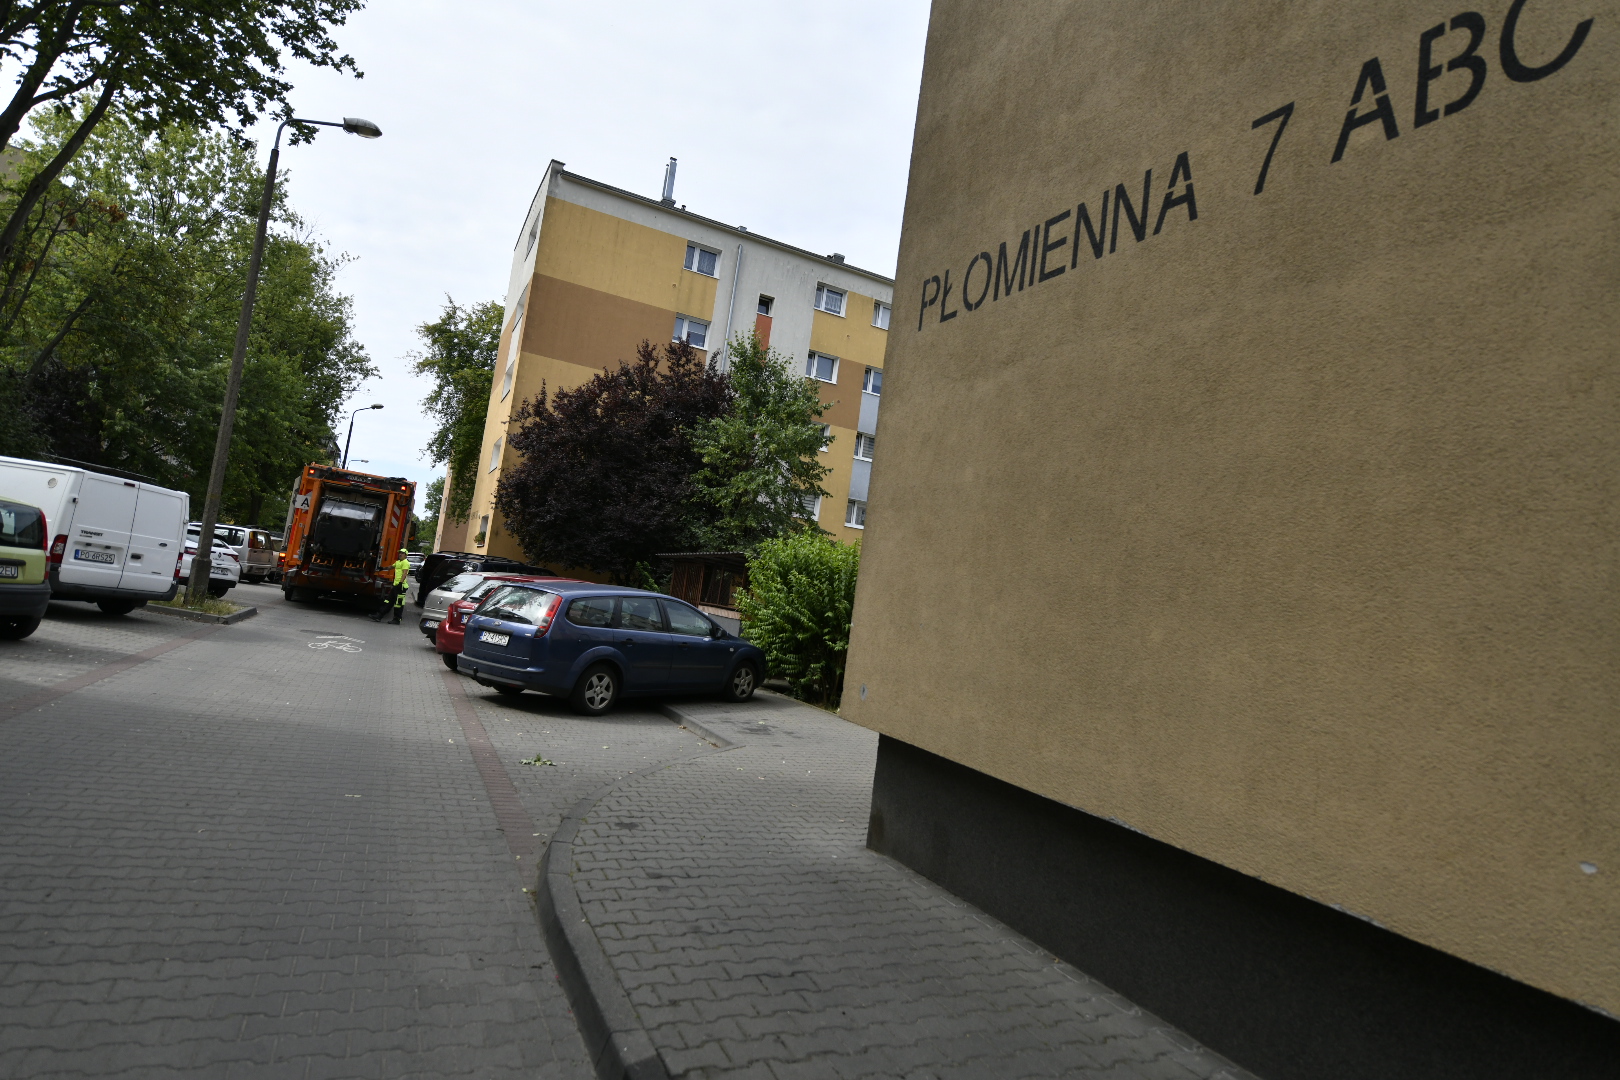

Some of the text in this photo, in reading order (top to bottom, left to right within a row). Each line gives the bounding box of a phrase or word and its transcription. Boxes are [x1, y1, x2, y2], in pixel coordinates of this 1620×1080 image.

[918, 0, 1594, 331] PŁOMIENNA 7 ABC
[300, 497, 309, 507] A
